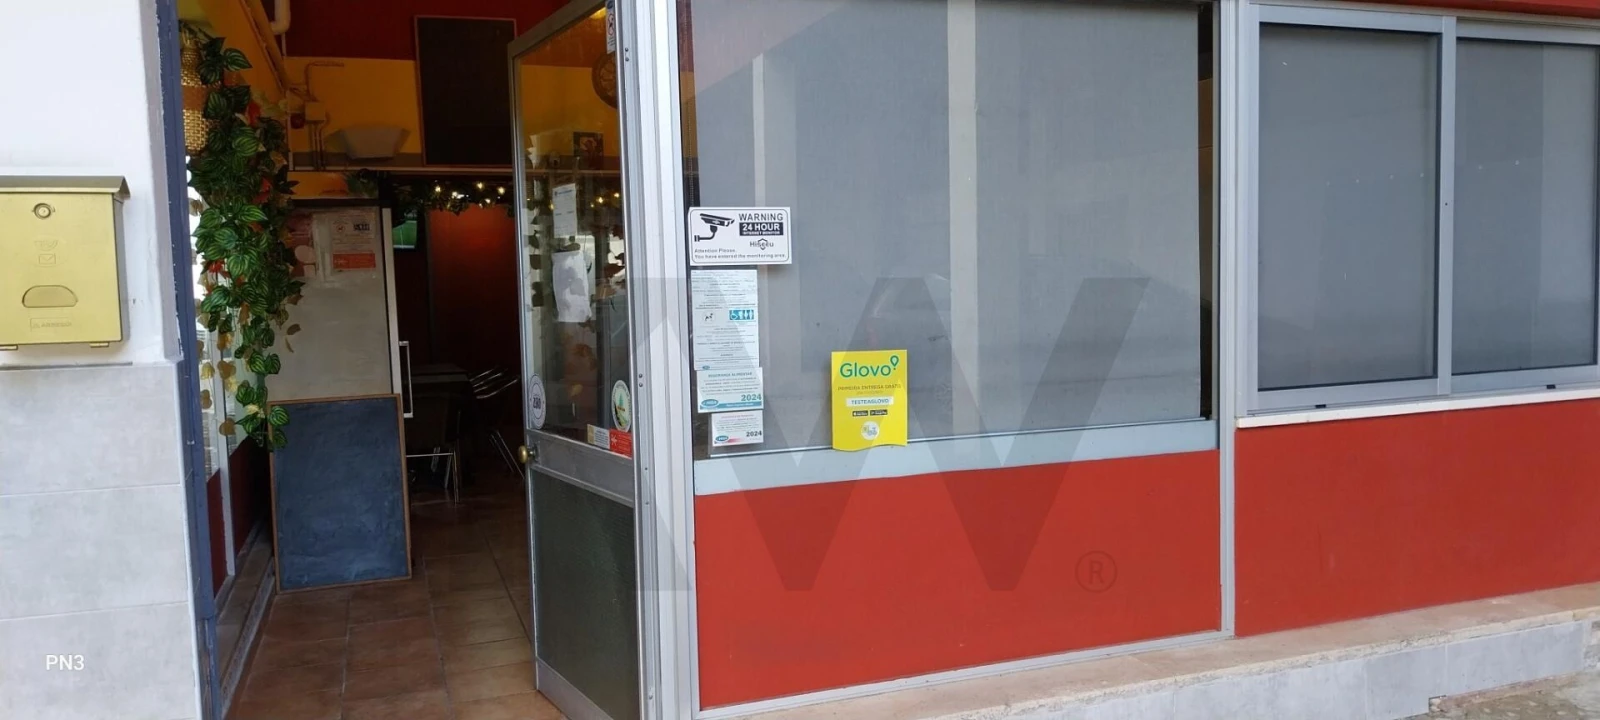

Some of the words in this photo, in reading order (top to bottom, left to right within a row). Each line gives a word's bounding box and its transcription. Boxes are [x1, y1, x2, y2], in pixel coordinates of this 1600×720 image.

[739, 213, 783, 221] WARNING
[742, 223, 753, 231] 24
[754, 223, 780, 231] HOUR
[840, 362, 891, 377] Glovo
[741, 394, 762, 402] 2024
